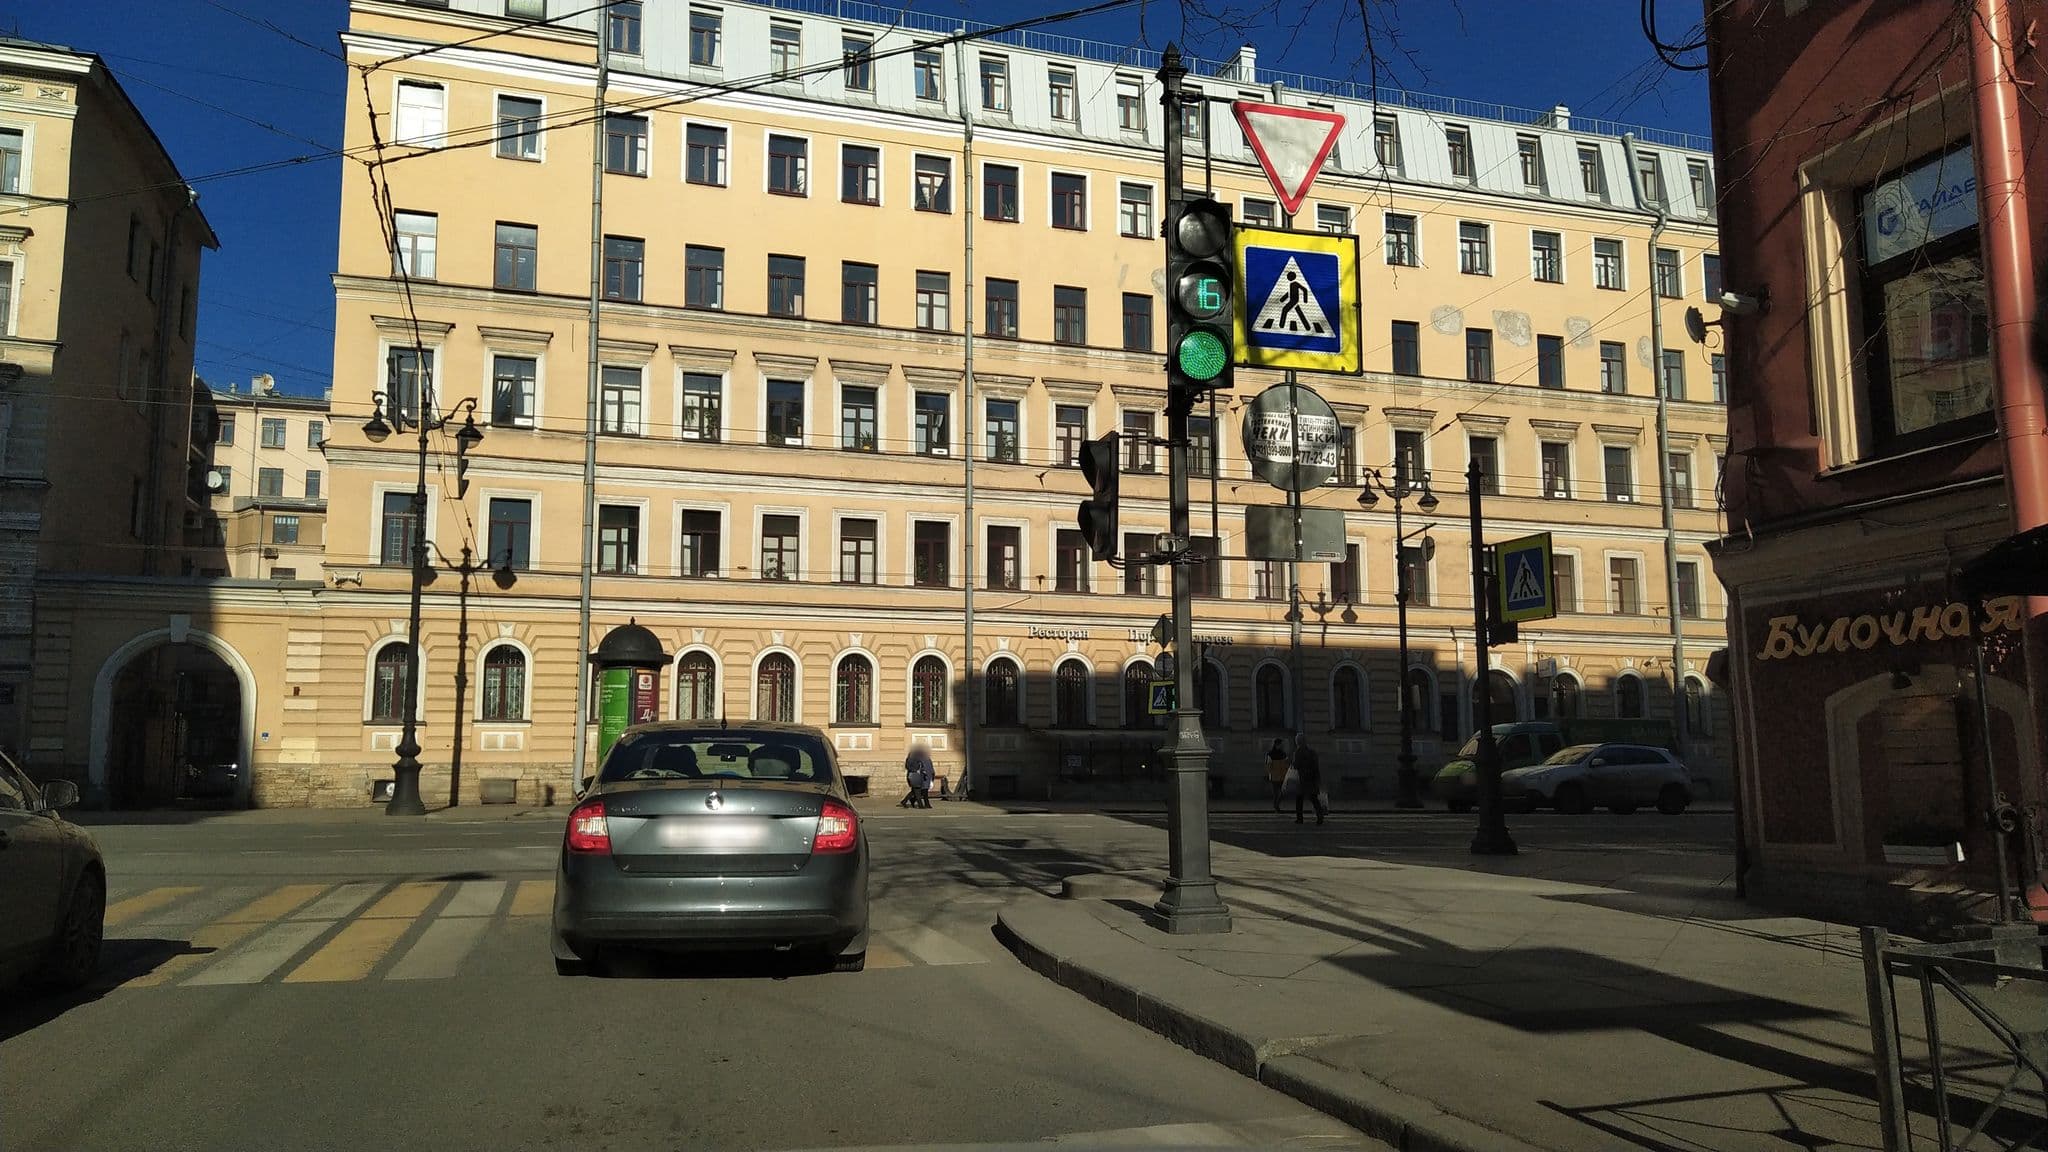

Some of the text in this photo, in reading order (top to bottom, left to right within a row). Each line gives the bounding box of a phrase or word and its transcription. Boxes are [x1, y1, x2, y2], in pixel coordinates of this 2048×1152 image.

[1198, 278, 1220, 309] 16
[1253, 426, 1289, 441] ЧЕКИ
[1028, 626, 1088, 641] Ресторан
[1756, 595, 2024, 661] Булочная
